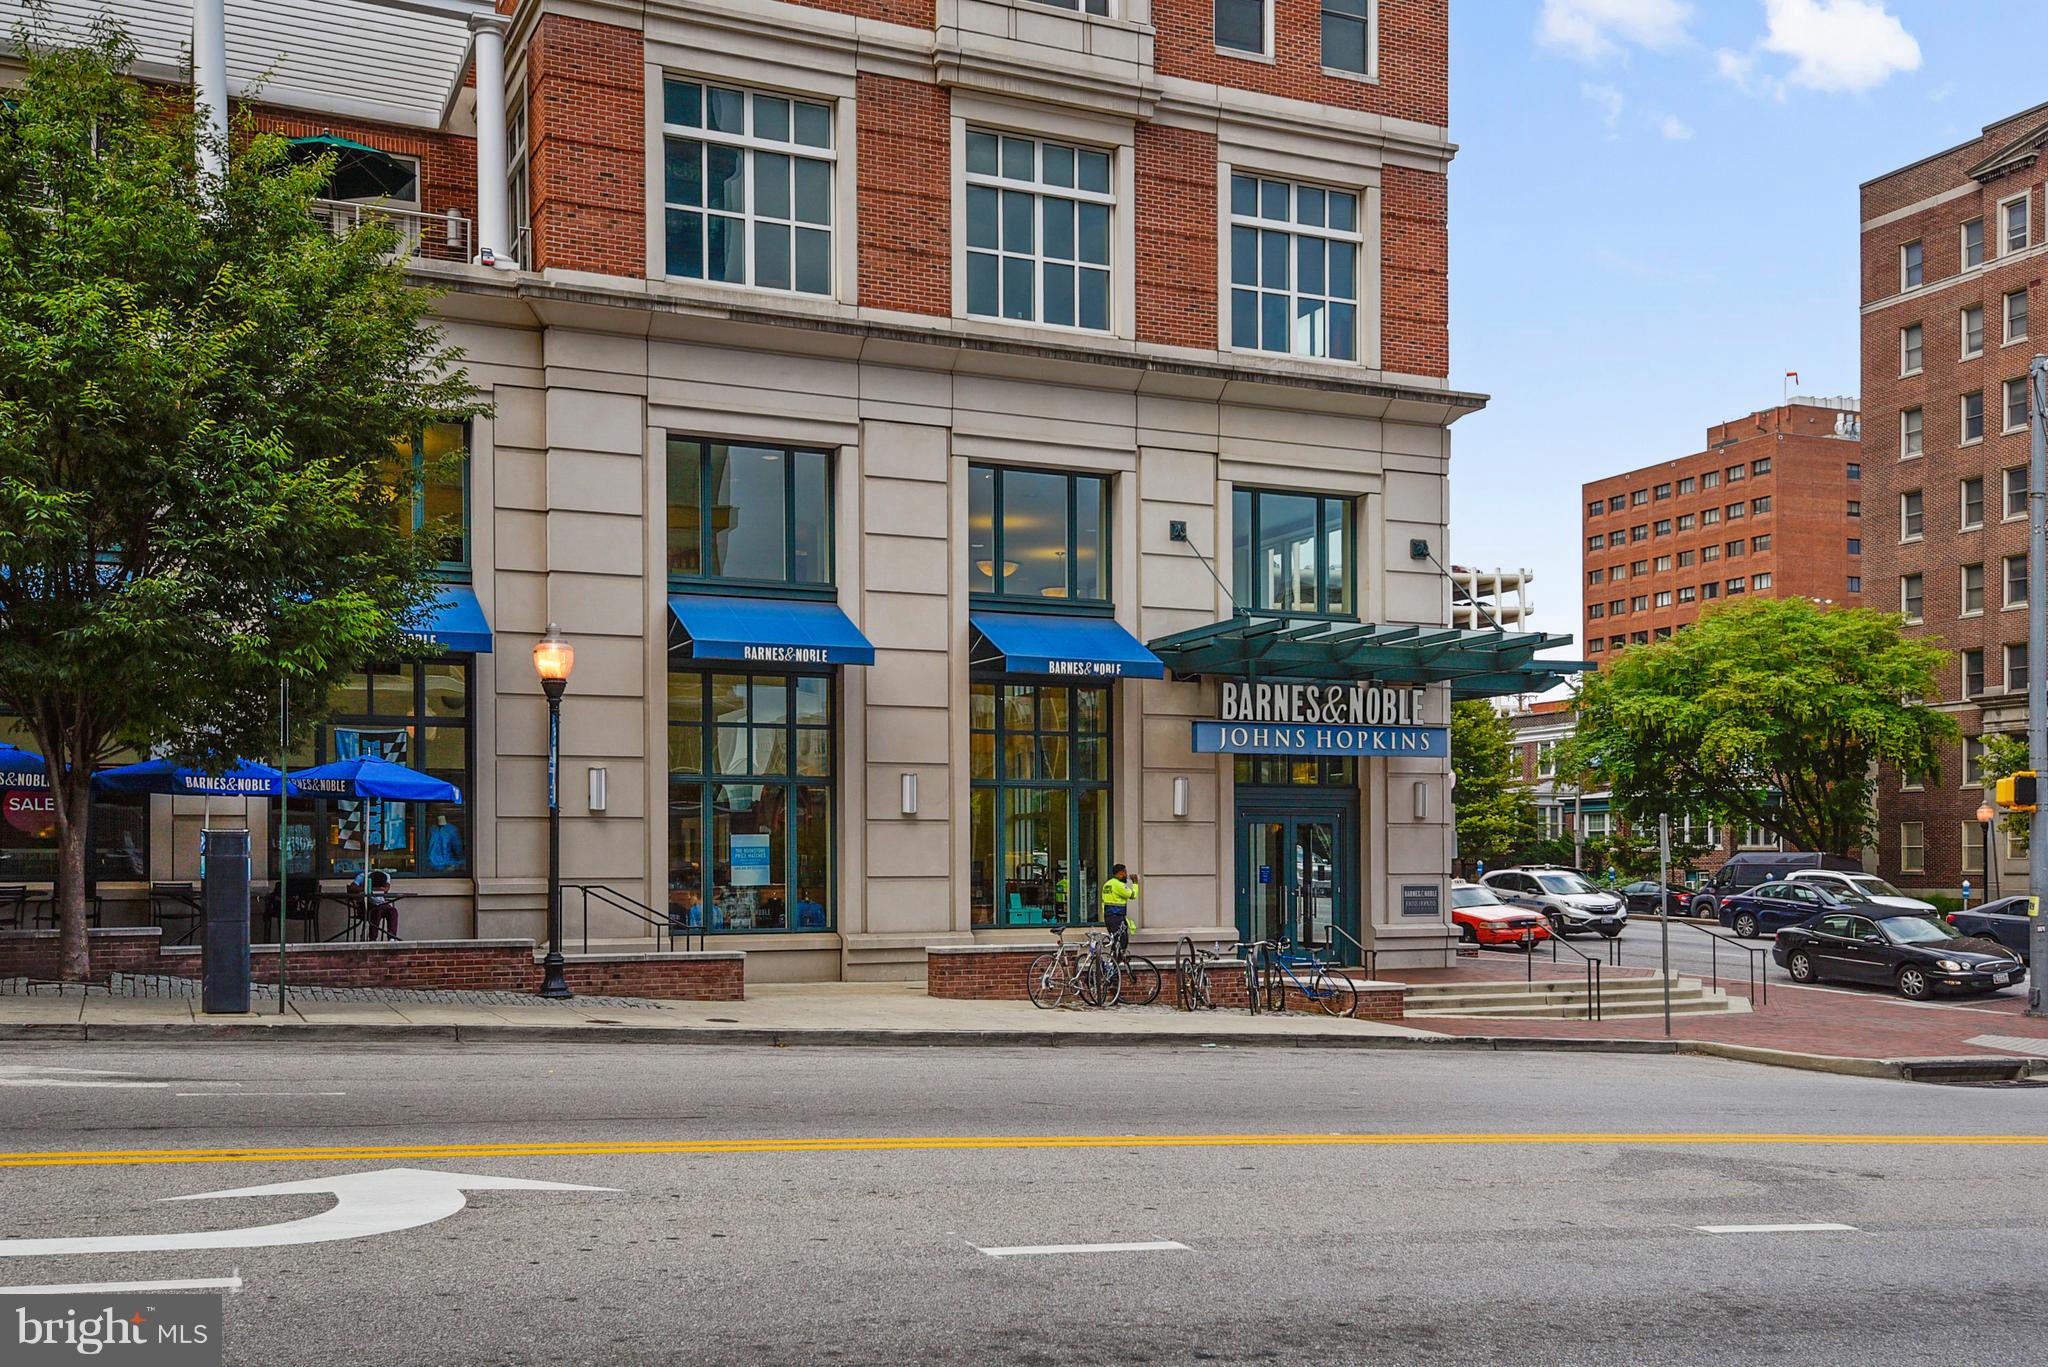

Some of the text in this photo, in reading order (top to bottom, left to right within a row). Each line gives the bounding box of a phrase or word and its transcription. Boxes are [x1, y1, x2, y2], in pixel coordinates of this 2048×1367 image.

[744, 646, 828, 663] BARNES&NOBLE
[1222, 682, 1425, 724] BARNES&NOBLE
[1219, 727, 1430, 751] JOHNS HOPKINS
[185, 776, 271, 791] BARNES&NOBLE
[9, 798, 55, 811] SALE
